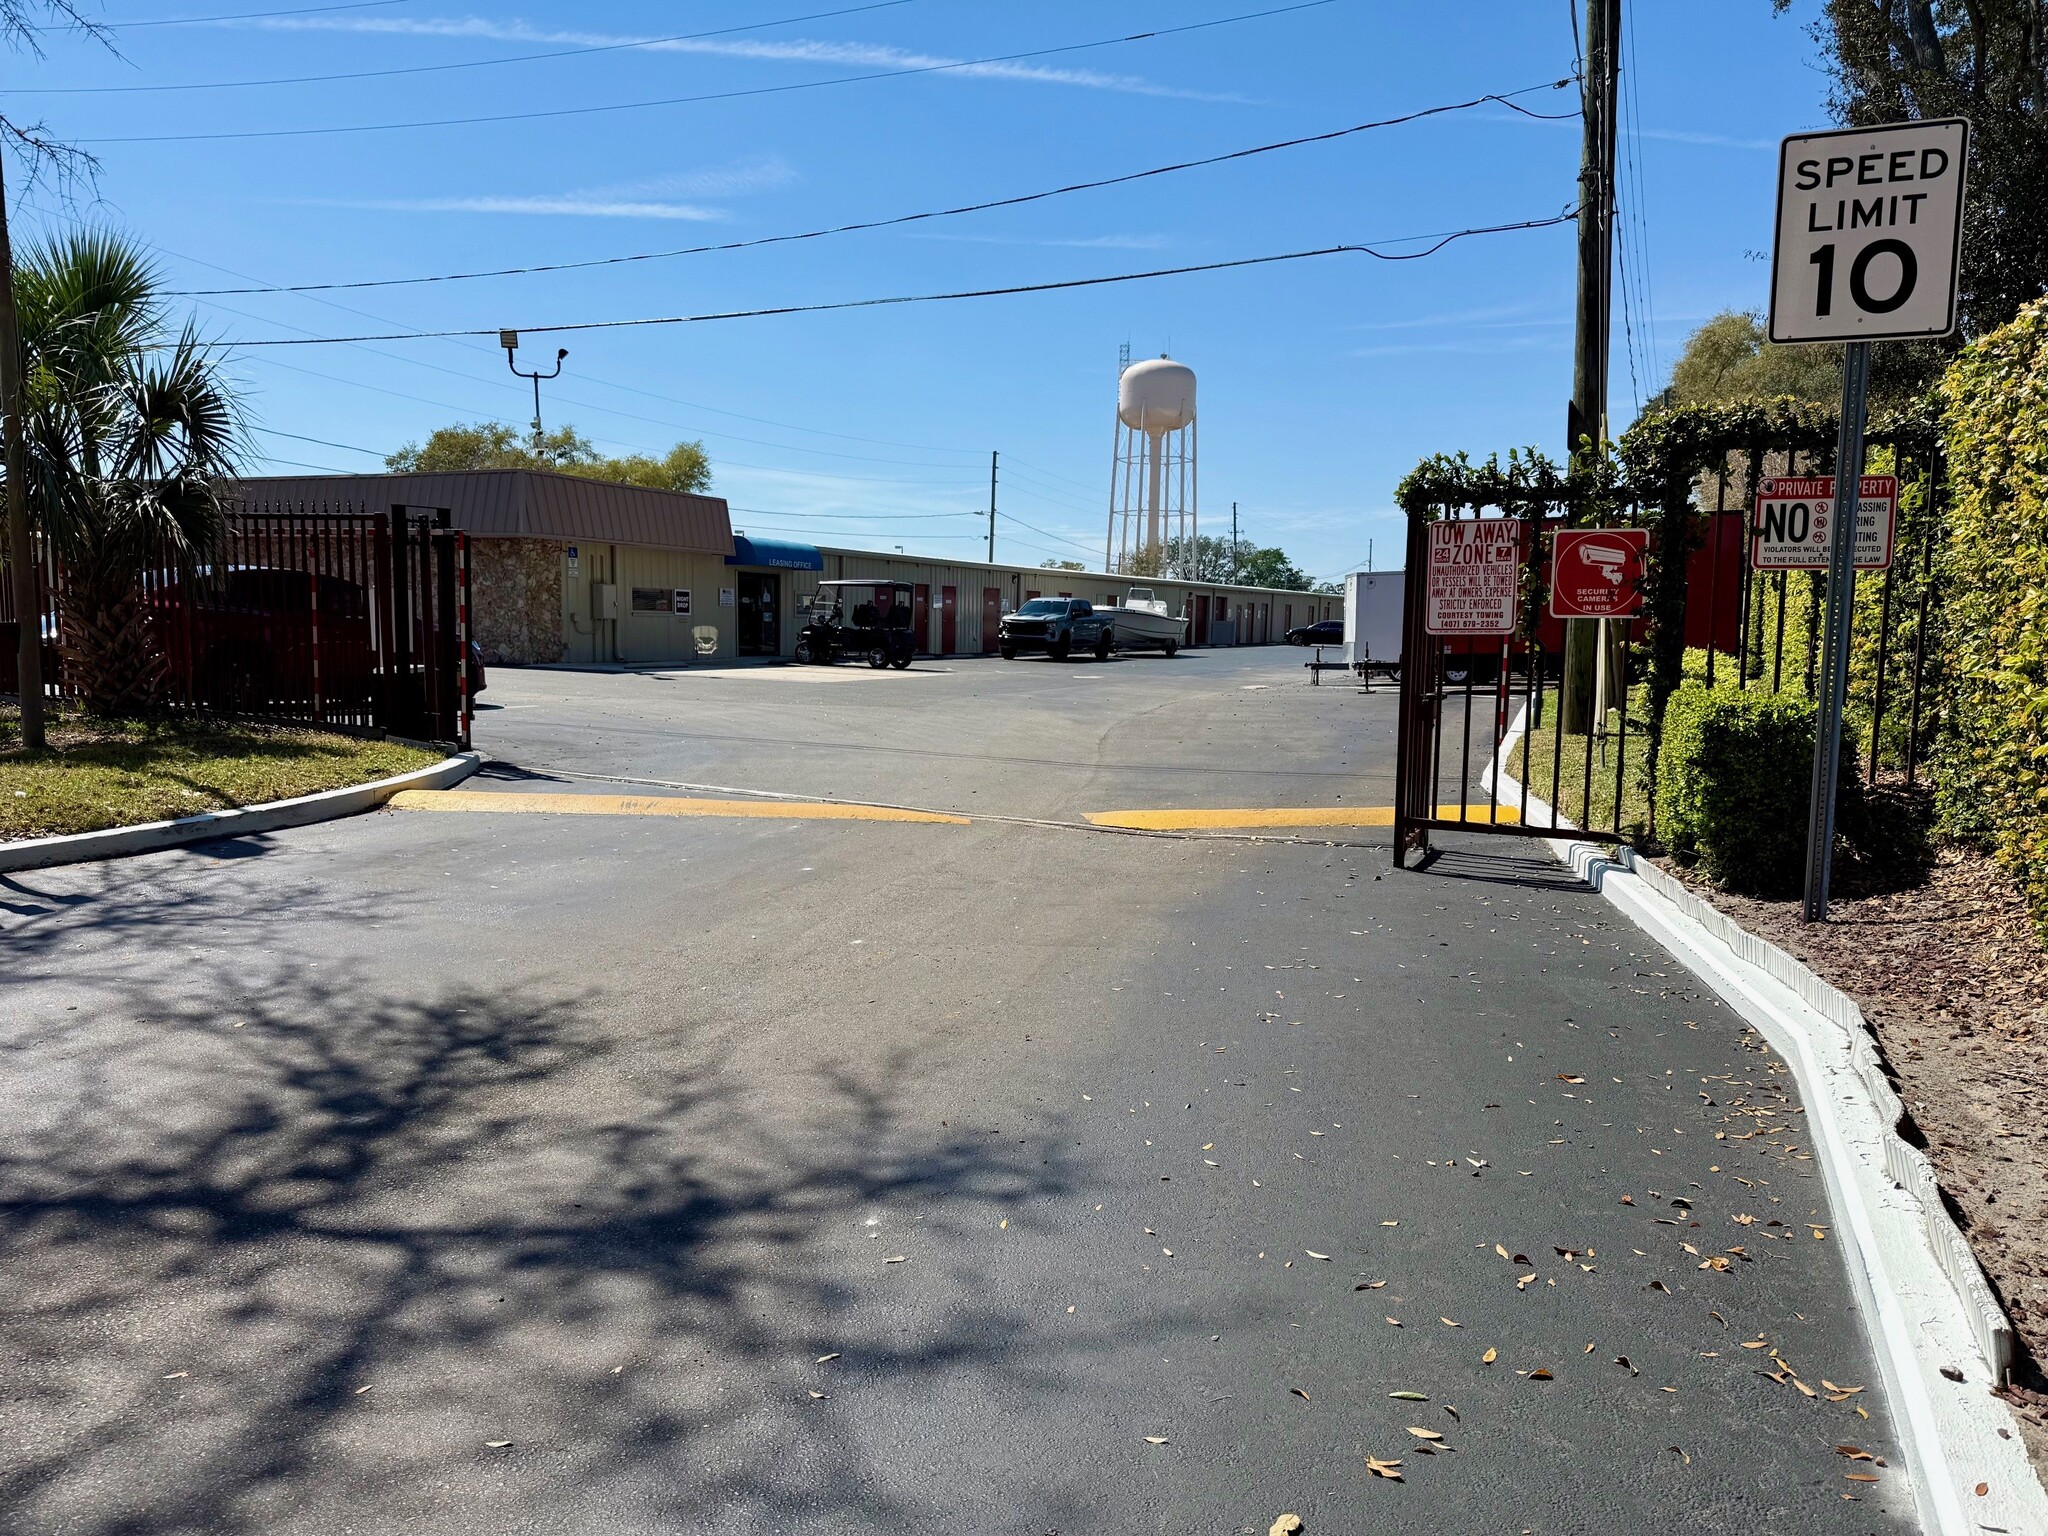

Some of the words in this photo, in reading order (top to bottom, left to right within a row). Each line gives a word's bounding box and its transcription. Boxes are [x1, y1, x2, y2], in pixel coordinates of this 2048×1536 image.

[1794, 148, 1949, 191] SPEED
[1808, 193, 1928, 233] LIMIT
[1809, 238, 1918, 317] 10
[1778, 481, 1824, 496] PRIVATE
[1829, 480, 1893, 495] PERTY
[1857, 501, 1887, 513] ASSING
[1764, 502, 1810, 543] NO
[1434, 524, 1466, 545] TOW
[1473, 522, 1514, 544] AWAY
[1436, 549, 1449, 558] 24
[1452, 543, 1494, 565] ZONE
[1500, 547, 1507, 556] 7
[1803, 545, 1821, 553] WILL
[768, 558, 793, 568] LEASING
[793, 561, 812, 569] OFFICE
[1762, 556, 1772, 564] TO
[1432, 565, 1480, 576] UNAUTHORIZED
[1482, 564, 1513, 576] VEHICLES
[1431, 577, 1440, 587] OR
[1442, 576, 1466, 587] VESSELS
[1468, 576, 1482, 587] WILL
[1483, 575, 1491, 587] BE
[1493, 575, 1513, 587] TOWED
[1431, 587, 1447, 598] AWAY
[1448, 587, 1456, 598] AT
[1458, 587, 1483, 598] OWNERS
[1485, 587, 1512, 597] EXPENSE
[1439, 599, 1466, 610] STRICTLY
[1469, 599, 1502, 610] ENFORCED
